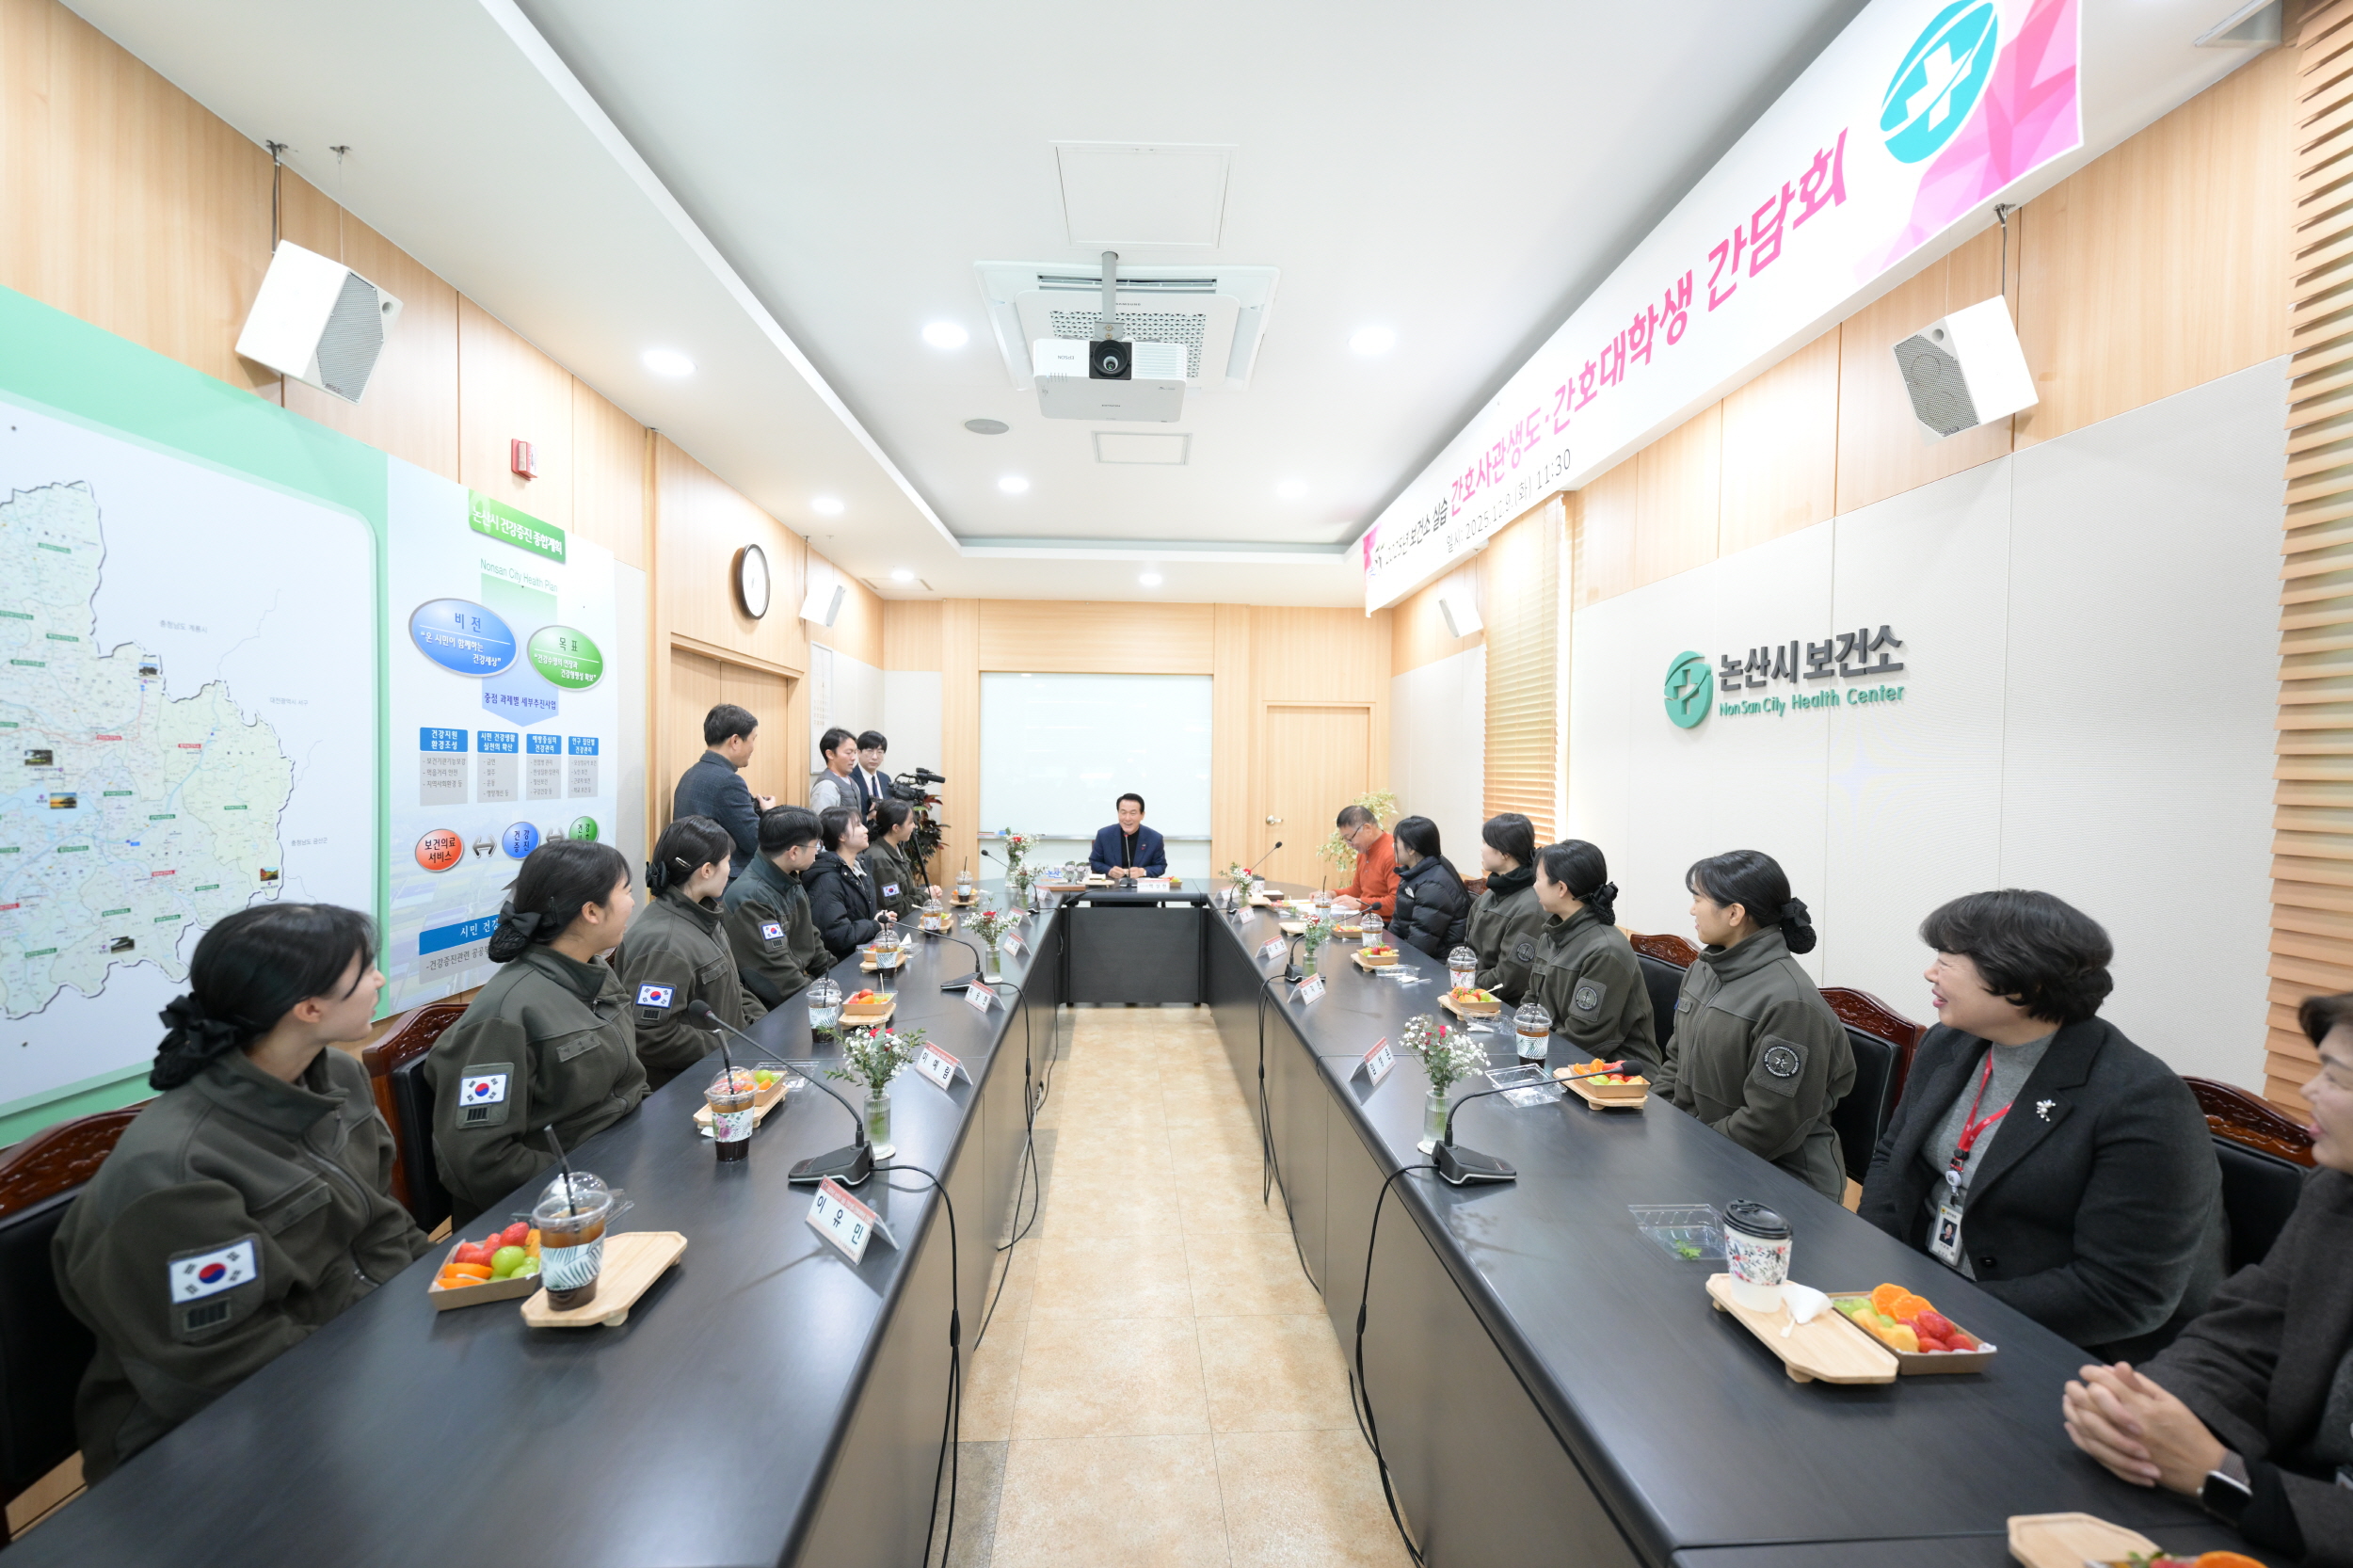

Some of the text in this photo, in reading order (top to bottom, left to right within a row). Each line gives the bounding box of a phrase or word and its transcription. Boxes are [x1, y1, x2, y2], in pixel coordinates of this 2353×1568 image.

[1410, 514, 1431, 547] 보건소
[1433, 496, 1449, 533] 실습
[1707, 125, 1849, 312] 간담회
[1536, 448, 1571, 490] 11:30
[472, 505, 563, 555] 논산시 건강증진 종합계획
[480, 558, 558, 593] Nonsan City Health Plan
[435, 633, 456, 648] 시민이
[457, 638, 484, 652] 함께하는
[484, 692, 556, 711] 중점 과제별 세부추진사업
[1762, 696, 1786, 717] City
[1791, 689, 1840, 710] Health
[1847, 684, 1905, 706] Center
[431, 729, 458, 740] 건강지원
[480, 732, 492, 741] 시민
[431, 740, 457, 750] 환경조성
[424, 837, 456, 851] 보건의료
[428, 851, 453, 864] 서비스
[459, 922, 478, 938] 시민
